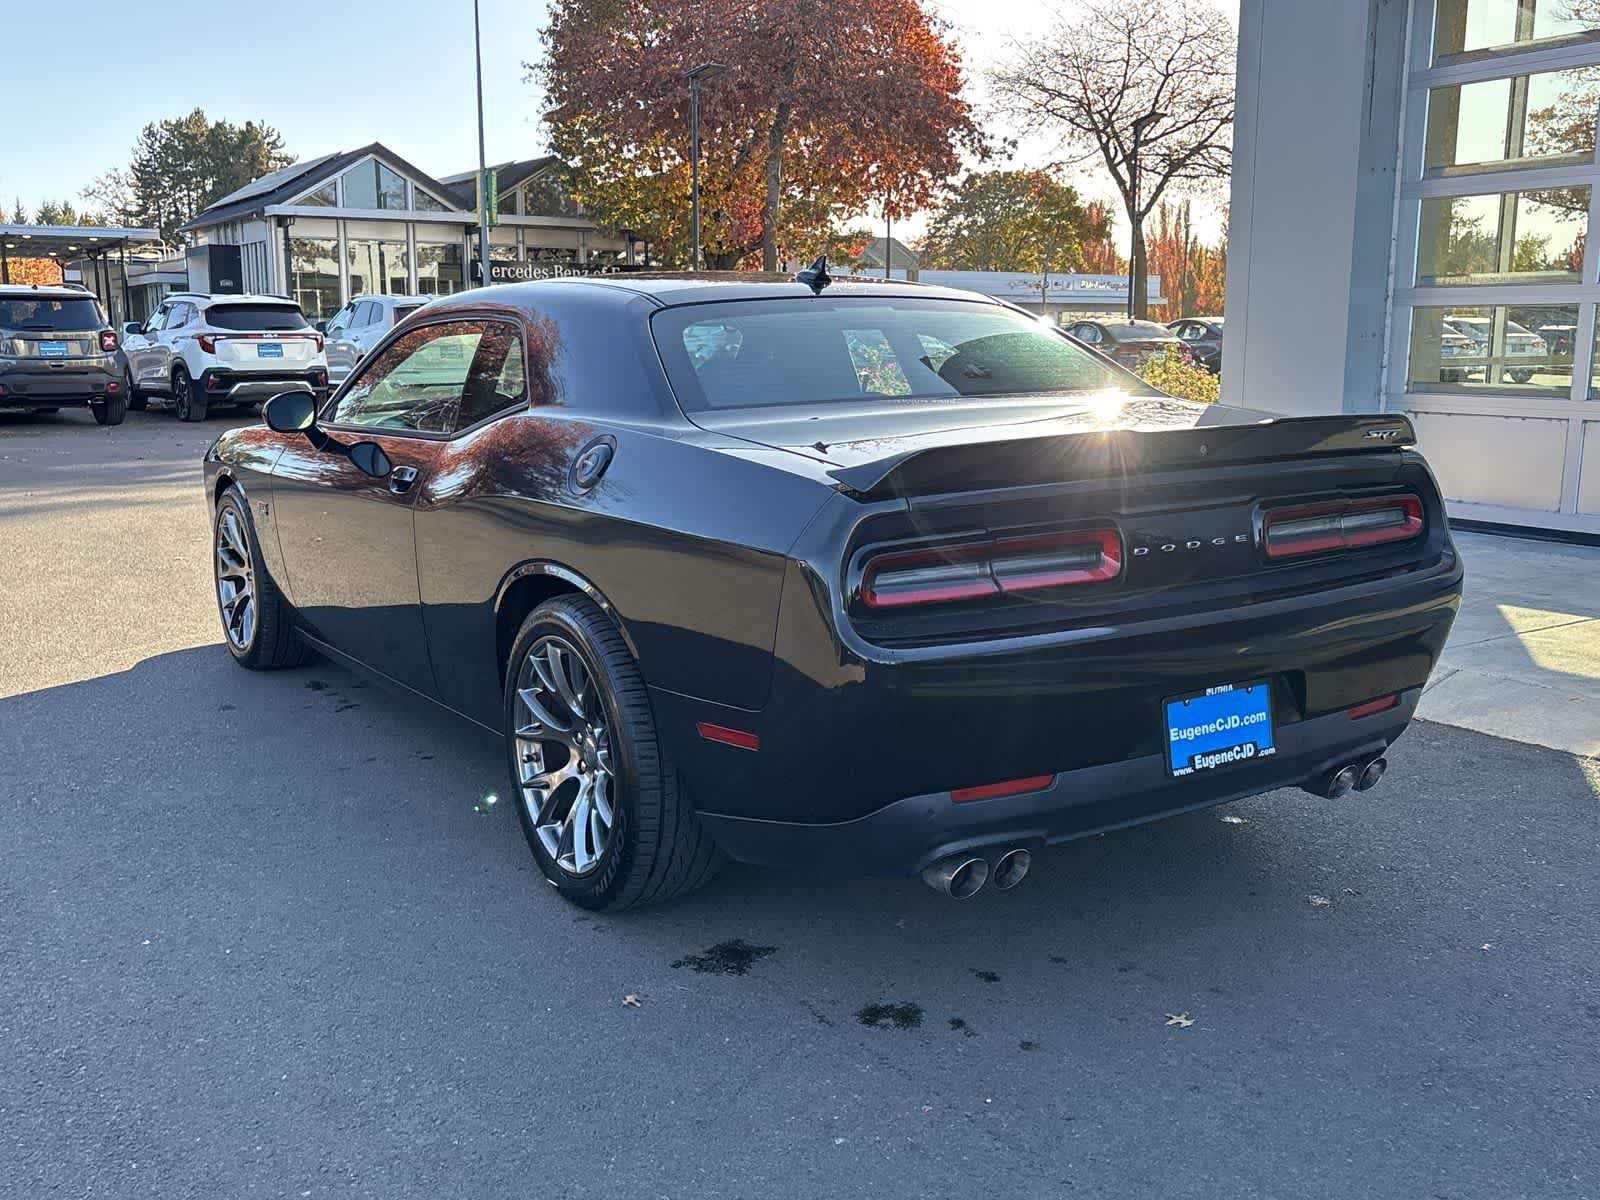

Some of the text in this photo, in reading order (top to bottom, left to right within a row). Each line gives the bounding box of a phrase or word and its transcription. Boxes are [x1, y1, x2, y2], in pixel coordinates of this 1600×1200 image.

[1134, 534, 1249, 556] DODGE
[1210, 684, 1233, 695] LITHIA
[1170, 711, 1267, 741] EugeneCJD.com
[1194, 743, 1255, 769] EugeneCJD
